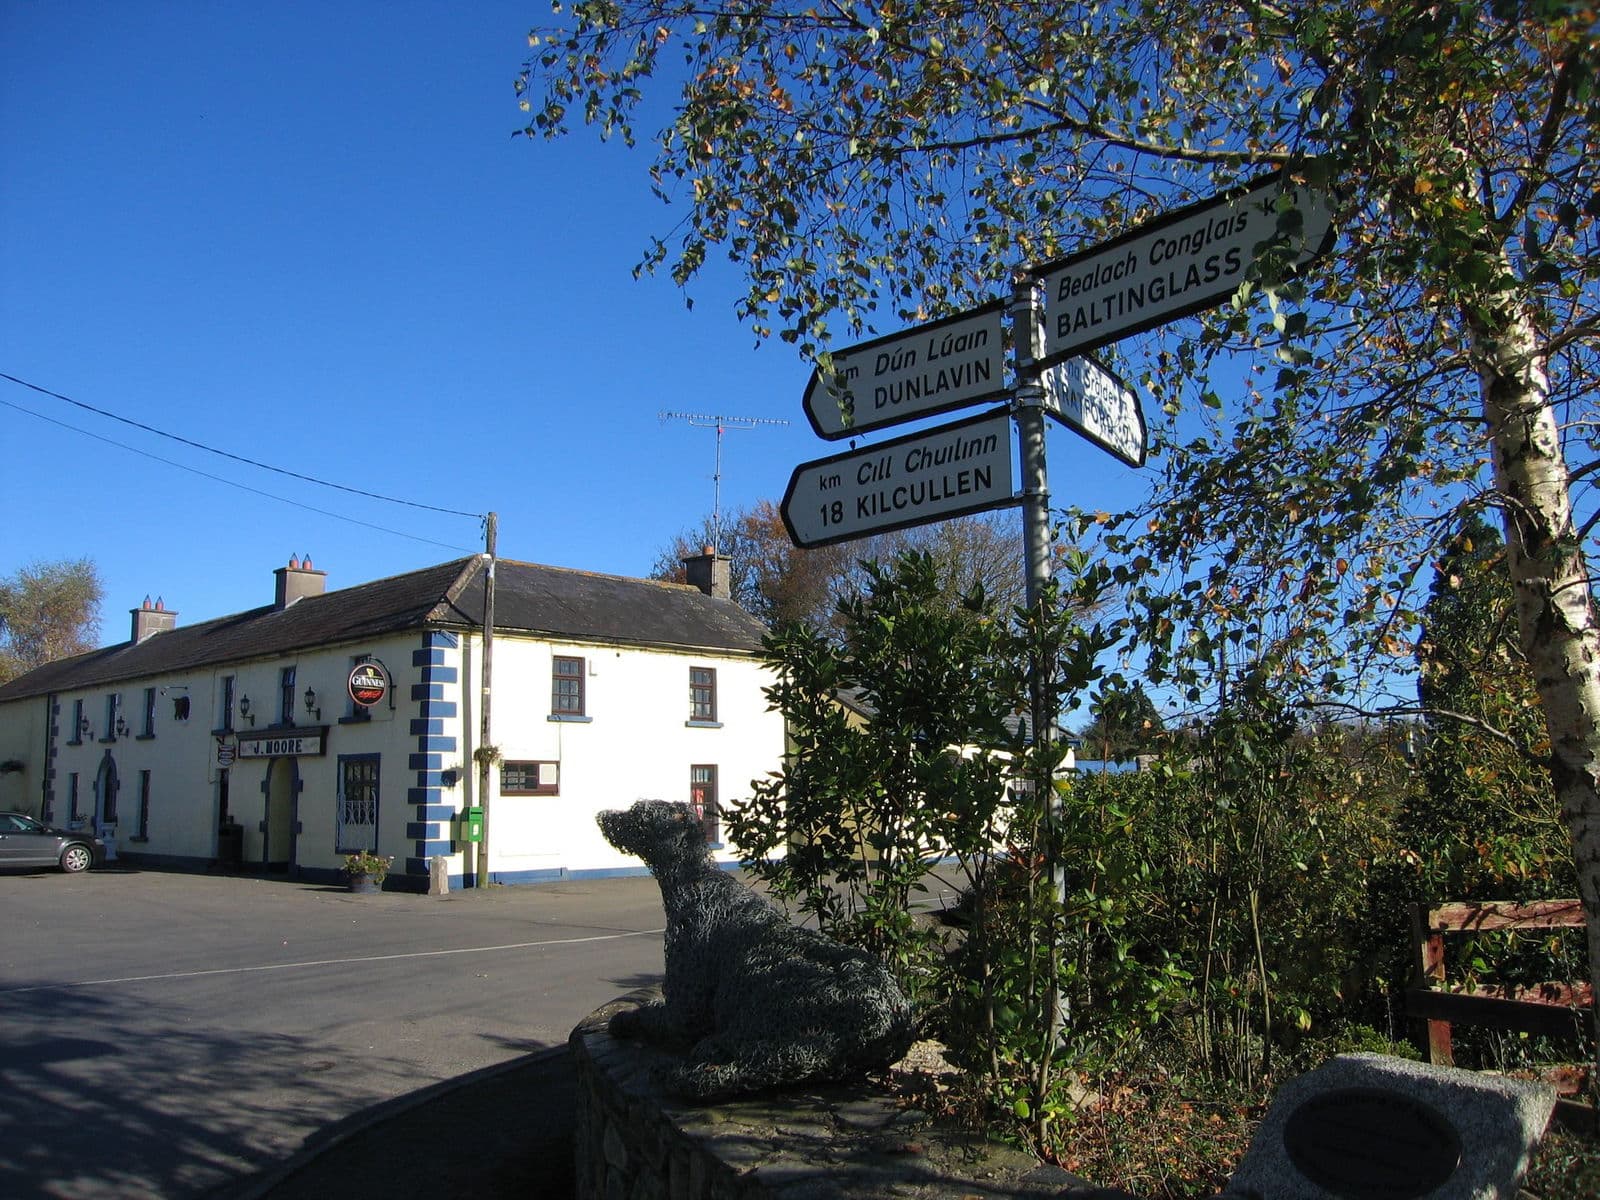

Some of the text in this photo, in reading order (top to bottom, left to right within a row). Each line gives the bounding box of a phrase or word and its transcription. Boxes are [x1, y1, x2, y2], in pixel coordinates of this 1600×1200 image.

[1057, 250, 1137, 303] Bealach
[1149, 211, 1249, 266] Conglais
[1057, 247, 1242, 339] BALTINGLASS
[874, 346, 917, 377] Dún
[927, 330, 989, 362] Lúain
[874, 357, 991, 410] DUNLAVIN
[819, 432, 998, 491] km Cill Chuilinn
[819, 465, 993, 527] 18 KILCULLEN
[352, 675, 385, 688] GUINNESS
[253, 739, 303, 755] J. MOORE
